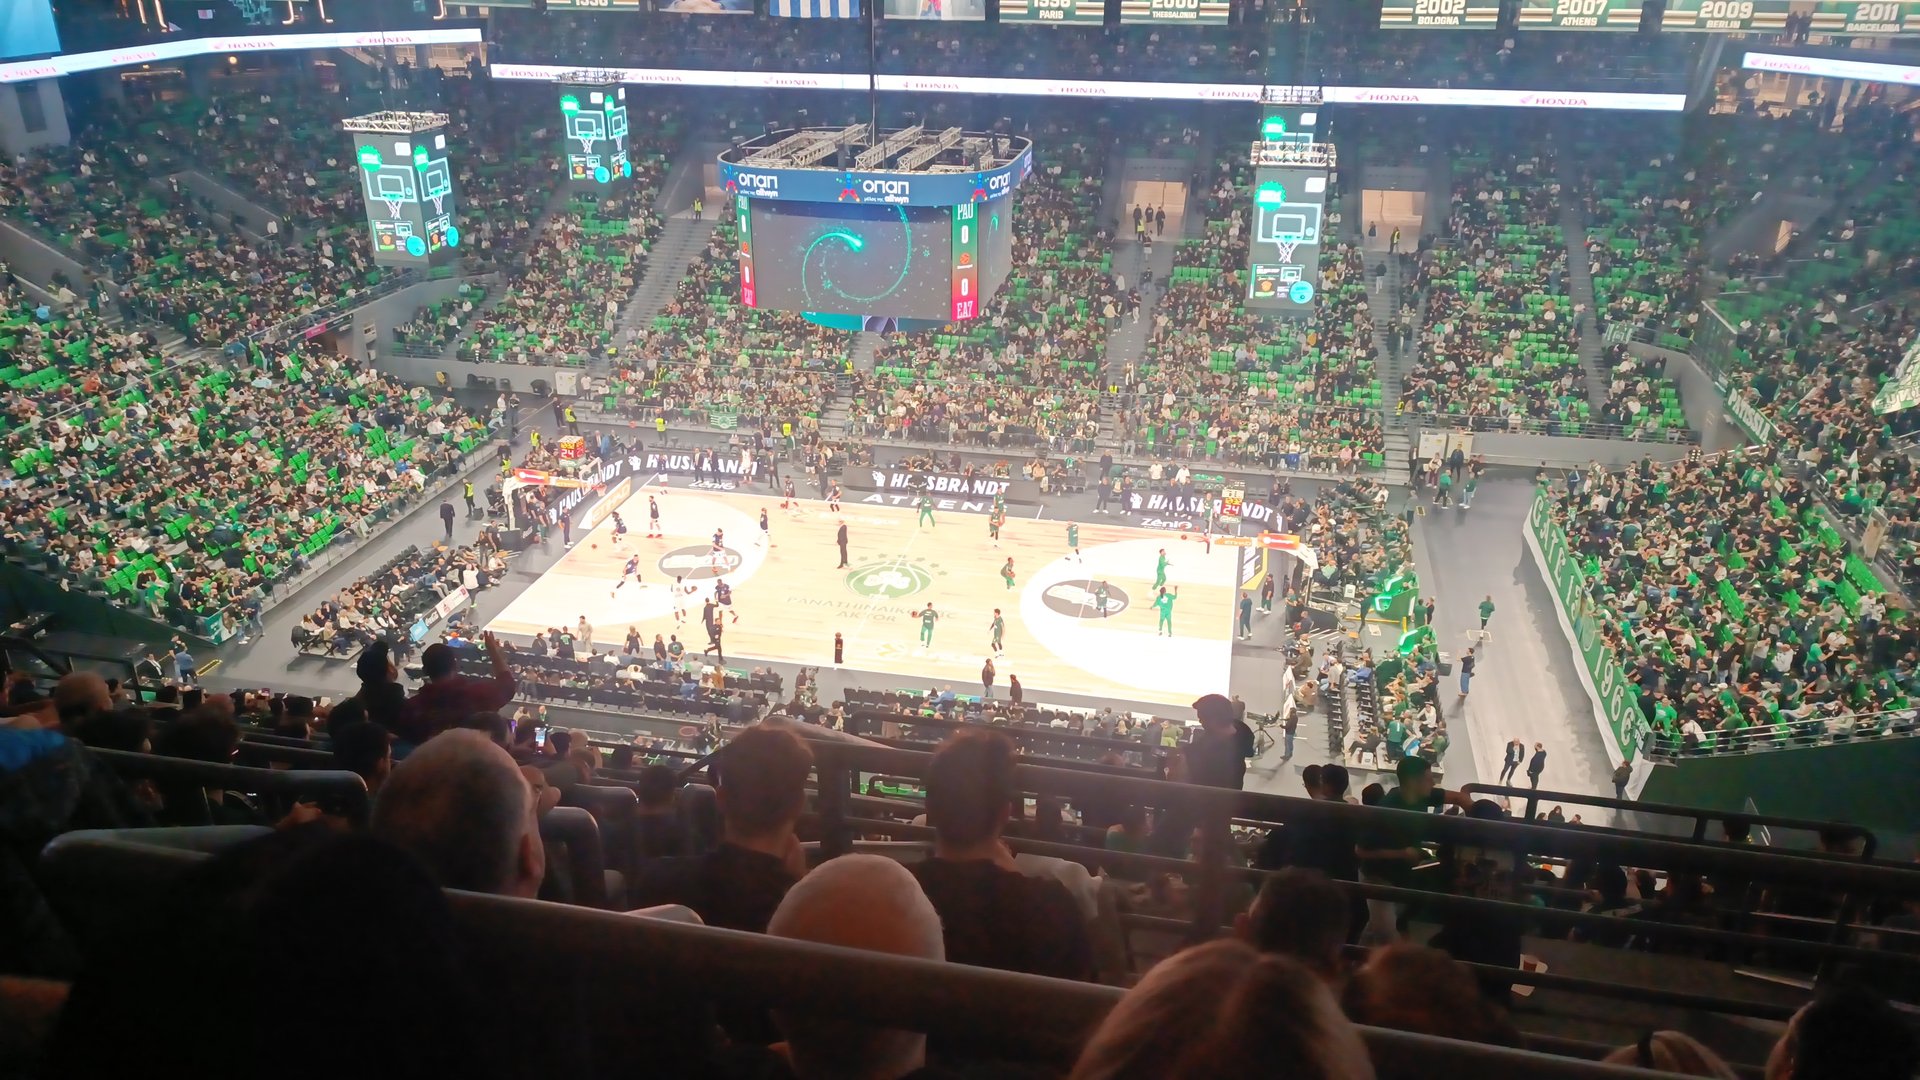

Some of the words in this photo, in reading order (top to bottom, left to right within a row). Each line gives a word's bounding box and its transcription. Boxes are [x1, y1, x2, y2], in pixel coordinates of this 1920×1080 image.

[1415, 0, 1466, 14] 2002
[1556, 0, 1608, 15] 2007
[1699, 1, 1754, 19] 2009
[1039, 10, 1064, 19] PARIS
[1152, 11, 1197, 19] THESSALONIKI
[1854, 3, 1899, 21] 2011
[1417, 16, 1459, 25] BOLOGNA
[1560, 17, 1597, 26] ATHENS
[1706, 20, 1740, 29] BERLIN
[1846, 23, 1900, 32] BARCELONA
[227, 41, 275, 49] HONDA
[1211, 90, 1259, 98] HONDA
[1369, 94, 1420, 102] HONDA
[1535, 97, 1588, 106] HONDA
[961, 225, 969, 244] 0
[961, 278, 969, 296] 0
[956, 301, 974, 320] EA7
[561, 449, 574, 458] 24
[1223, 504, 1240, 515] 24
[786, 596, 917, 616] PANATHINAIKO
[1594, 646, 1636, 746] 1966
